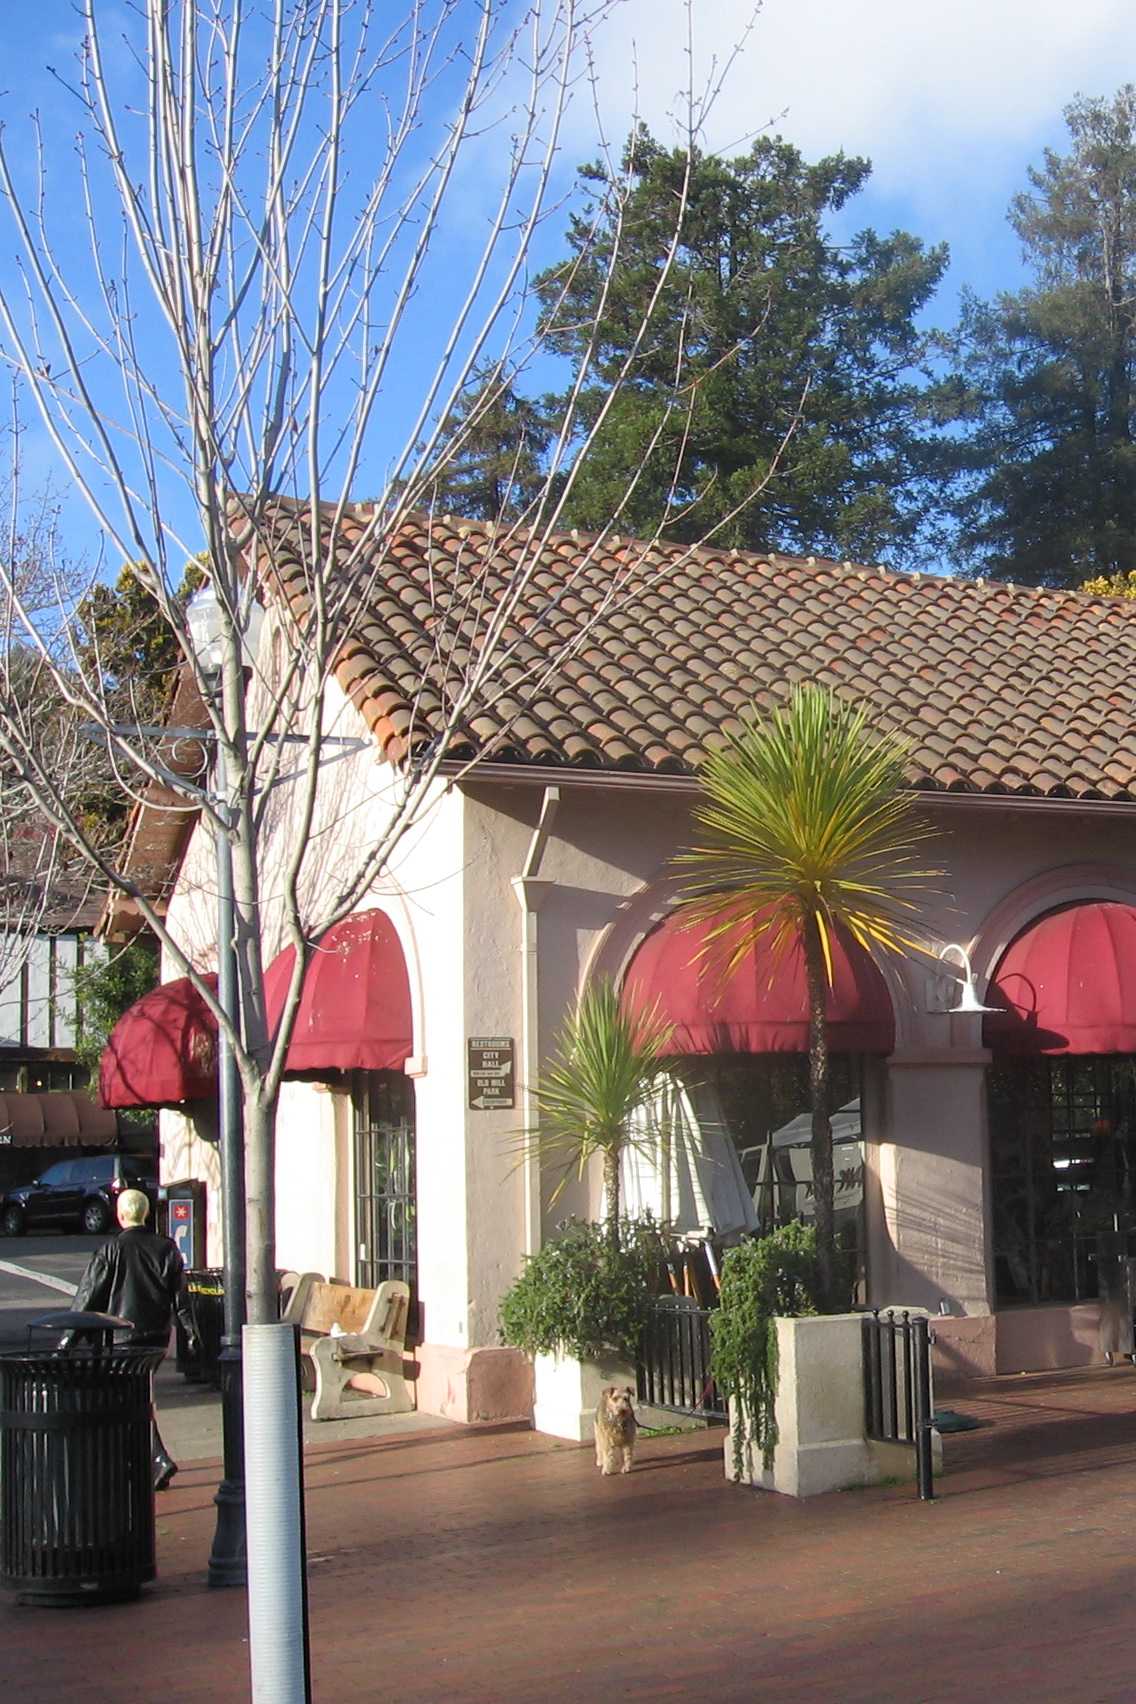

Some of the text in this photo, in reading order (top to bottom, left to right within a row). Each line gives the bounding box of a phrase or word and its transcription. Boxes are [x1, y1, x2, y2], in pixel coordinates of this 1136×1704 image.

[471, 1040, 510, 1048] RESTROOMS
[482, 1051, 499, 1059] CITY
[481, 1060, 499, 1068] HALL
[476, 1079, 489, 1087] OLD
[482, 1087, 500, 1095] PARK
